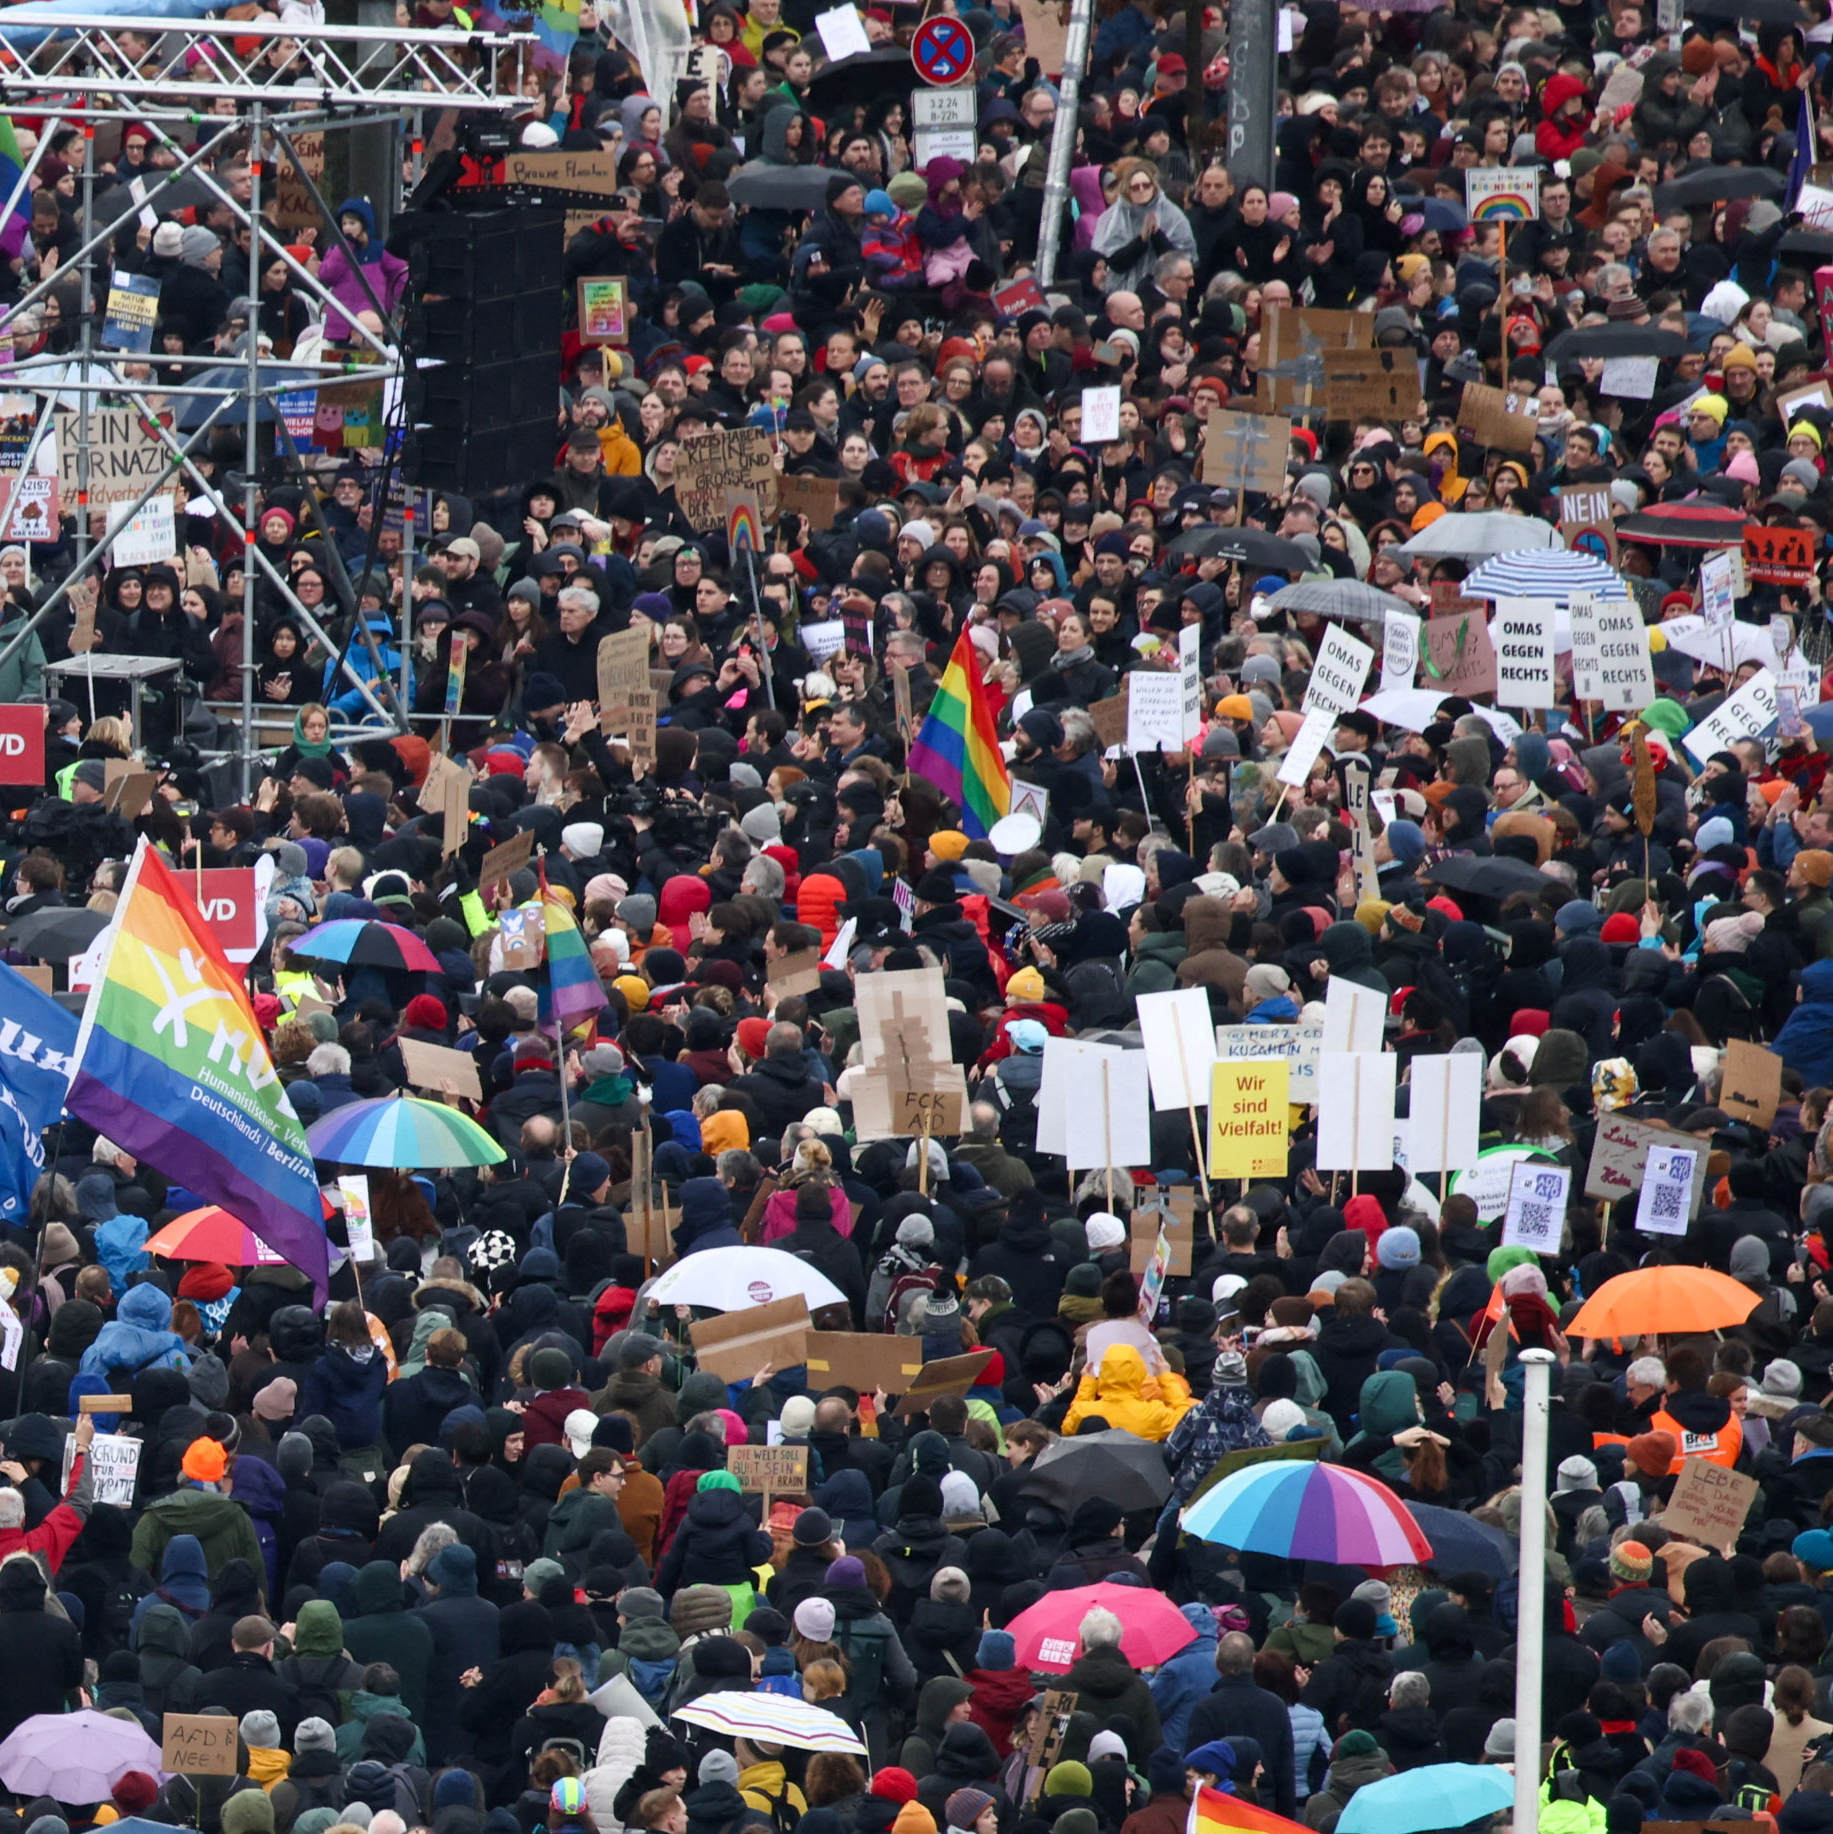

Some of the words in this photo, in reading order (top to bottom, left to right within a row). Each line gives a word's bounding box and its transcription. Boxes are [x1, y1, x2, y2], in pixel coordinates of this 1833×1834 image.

[1563, 491, 1610, 526] NEIN
[1503, 621, 1543, 636] OMAS
[1599, 616, 1634, 631] OMAS
[1573, 631, 1596, 646] GEGEN
[1326, 641, 1362, 674] OMAS
[1502, 644, 1544, 658] GEGEN
[1601, 643, 1639, 658] GEGEN
[1574, 658, 1599, 672] RECHTS
[1316, 664, 1357, 698] GEGEN
[1501, 666, 1549, 682] RECHTS
[1602, 669, 1647, 684] RECHTS
[1236, 1076, 1266, 1091] Wir
[198, 1064, 282, 1131] Humanistischer
[905, 1092, 945, 1110] FCK
[1232, 1098, 1268, 1114] sind
[189, 1084, 263, 1146] Deutschlands
[1218, 1119, 1283, 1137] Vielfalt!
[1686, 1431, 1714, 1444] Brot
[753, 1449, 778, 1461] WELT
[765, 1462, 794, 1476] SEIN
[1692, 1461, 1744, 1491] LEBE
[171, 1724, 217, 1747] AFD
[172, 1748, 210, 1768] NEE
